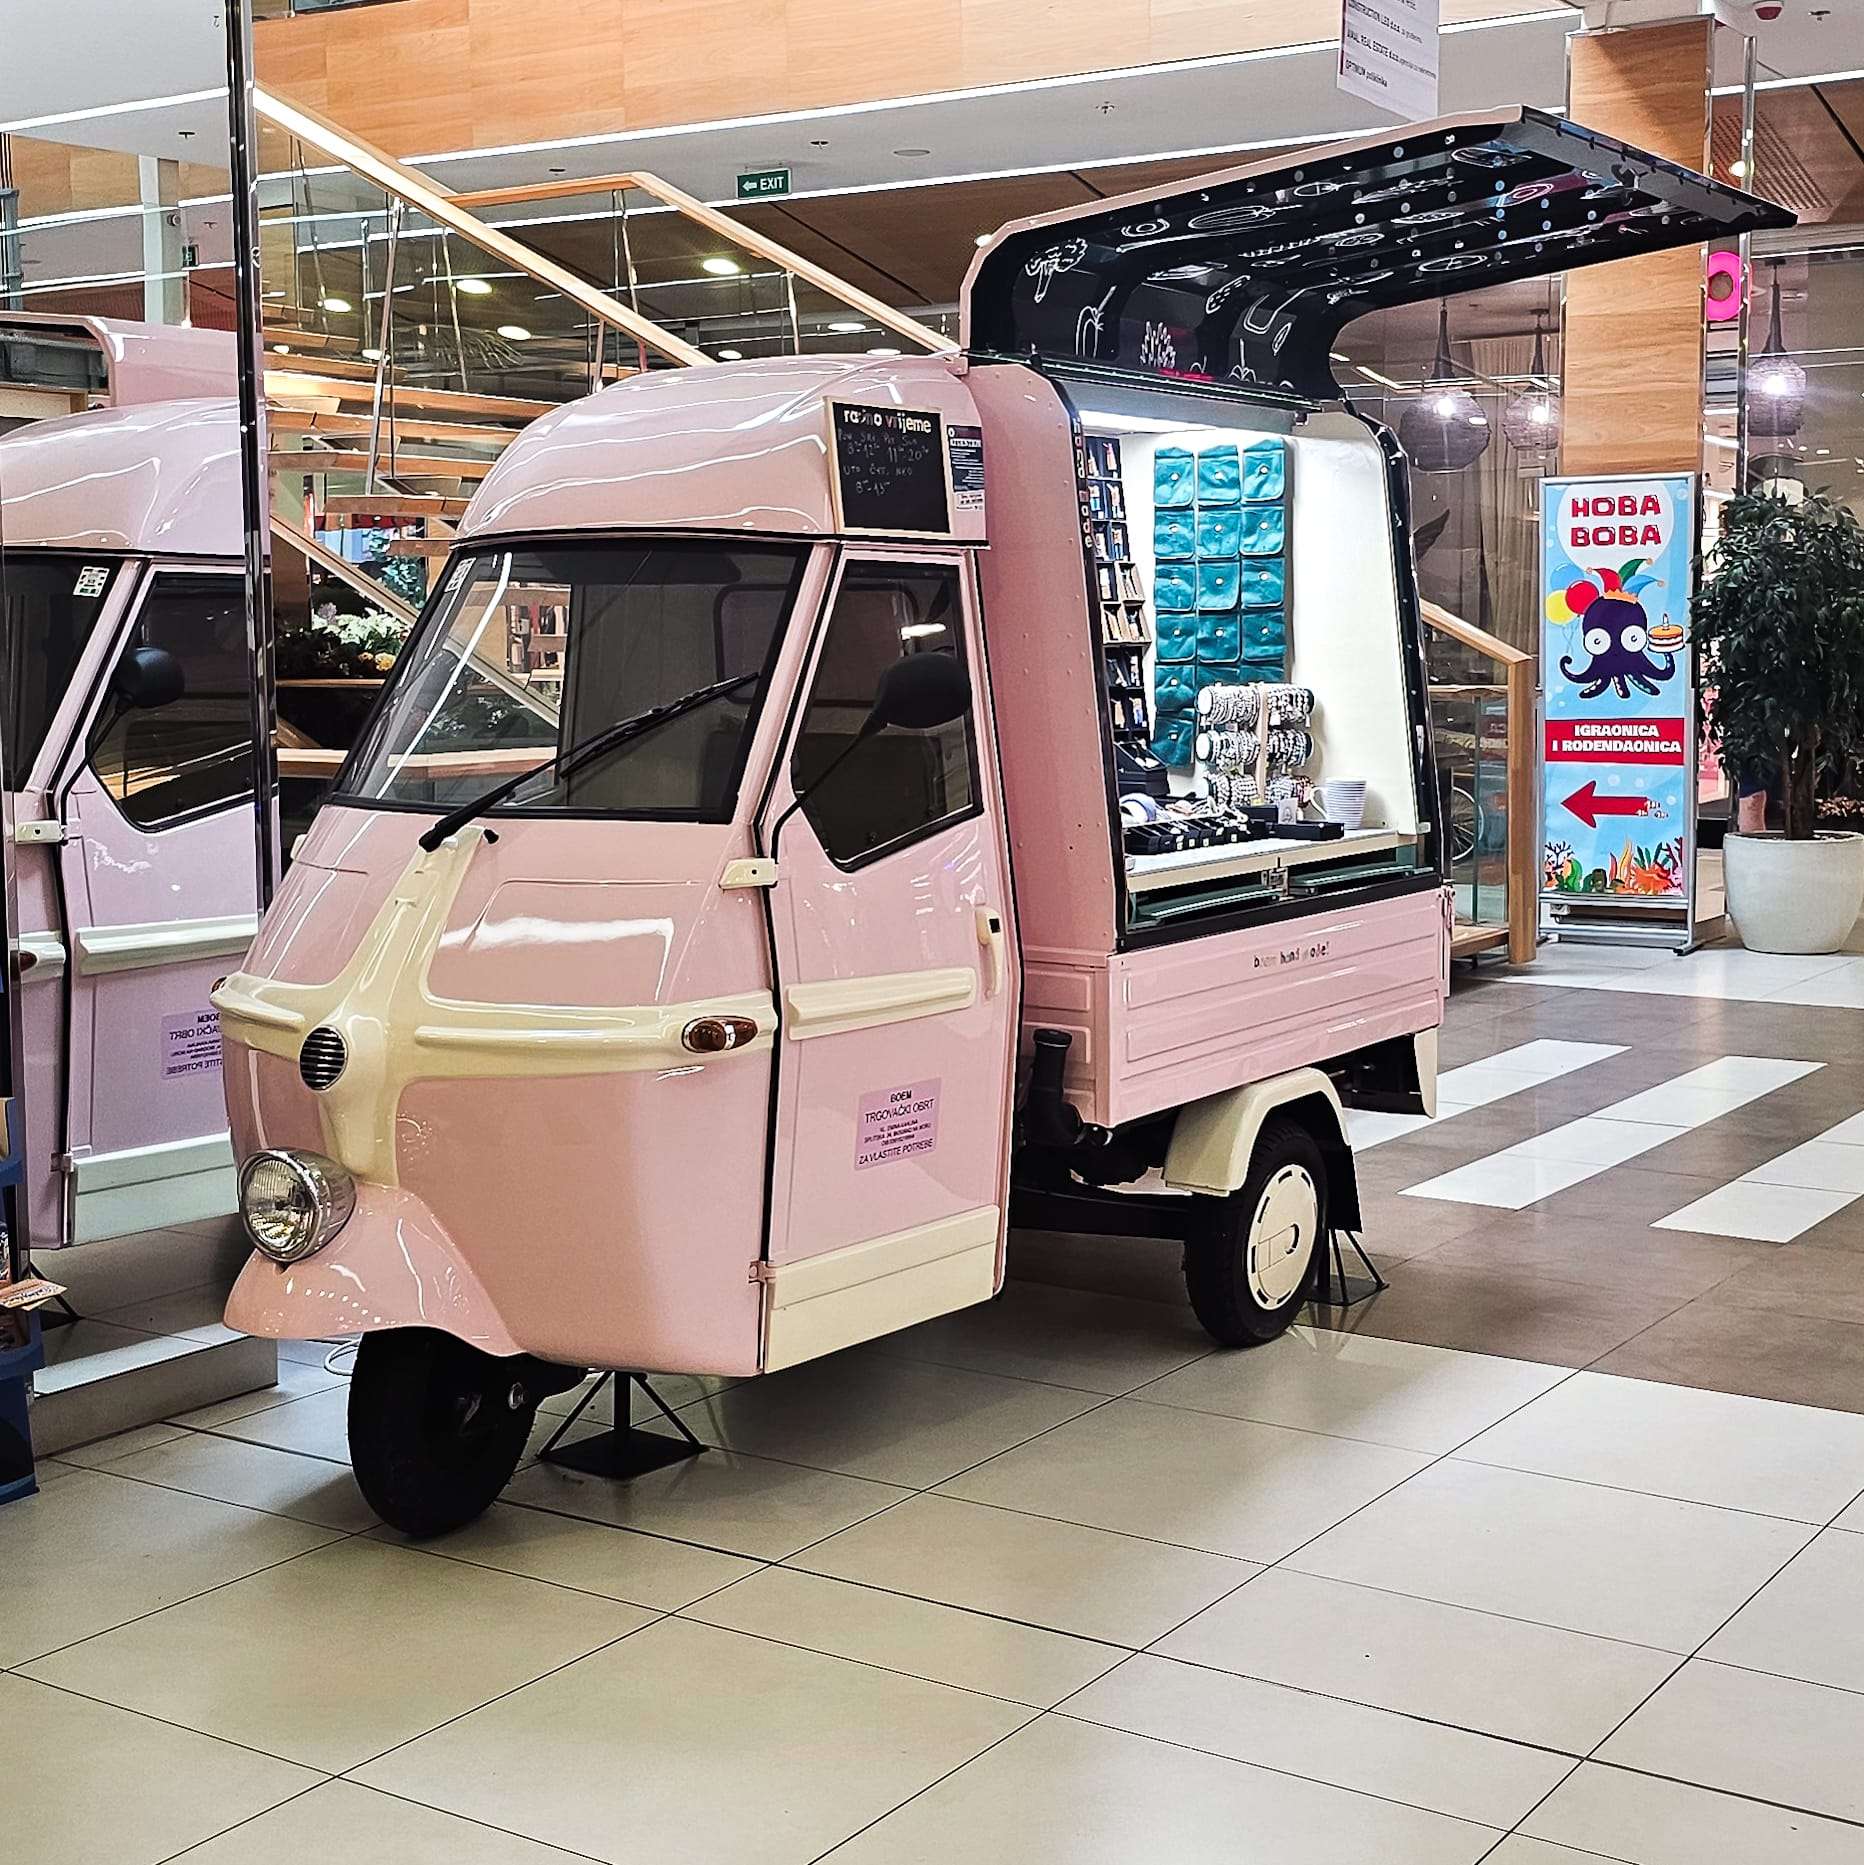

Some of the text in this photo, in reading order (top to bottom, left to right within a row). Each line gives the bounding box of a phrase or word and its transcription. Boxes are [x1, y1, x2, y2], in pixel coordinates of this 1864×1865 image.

[760, 176, 784, 191] EXIT
[884, 412, 932, 434] vrijeme
[1571, 494, 1661, 518] HOBA
[1570, 524, 1662, 547] BOBA
[1574, 724, 1660, 738] IGRAONICA
[1551, 740, 1558, 752] I
[890, 1090, 912, 1103] BOEM
[865, 1098, 935, 1123] TRGOVAČKI OBRT
[859, 1154, 869, 1165] ZA
[869, 1145, 902, 1162] VLASTITE
